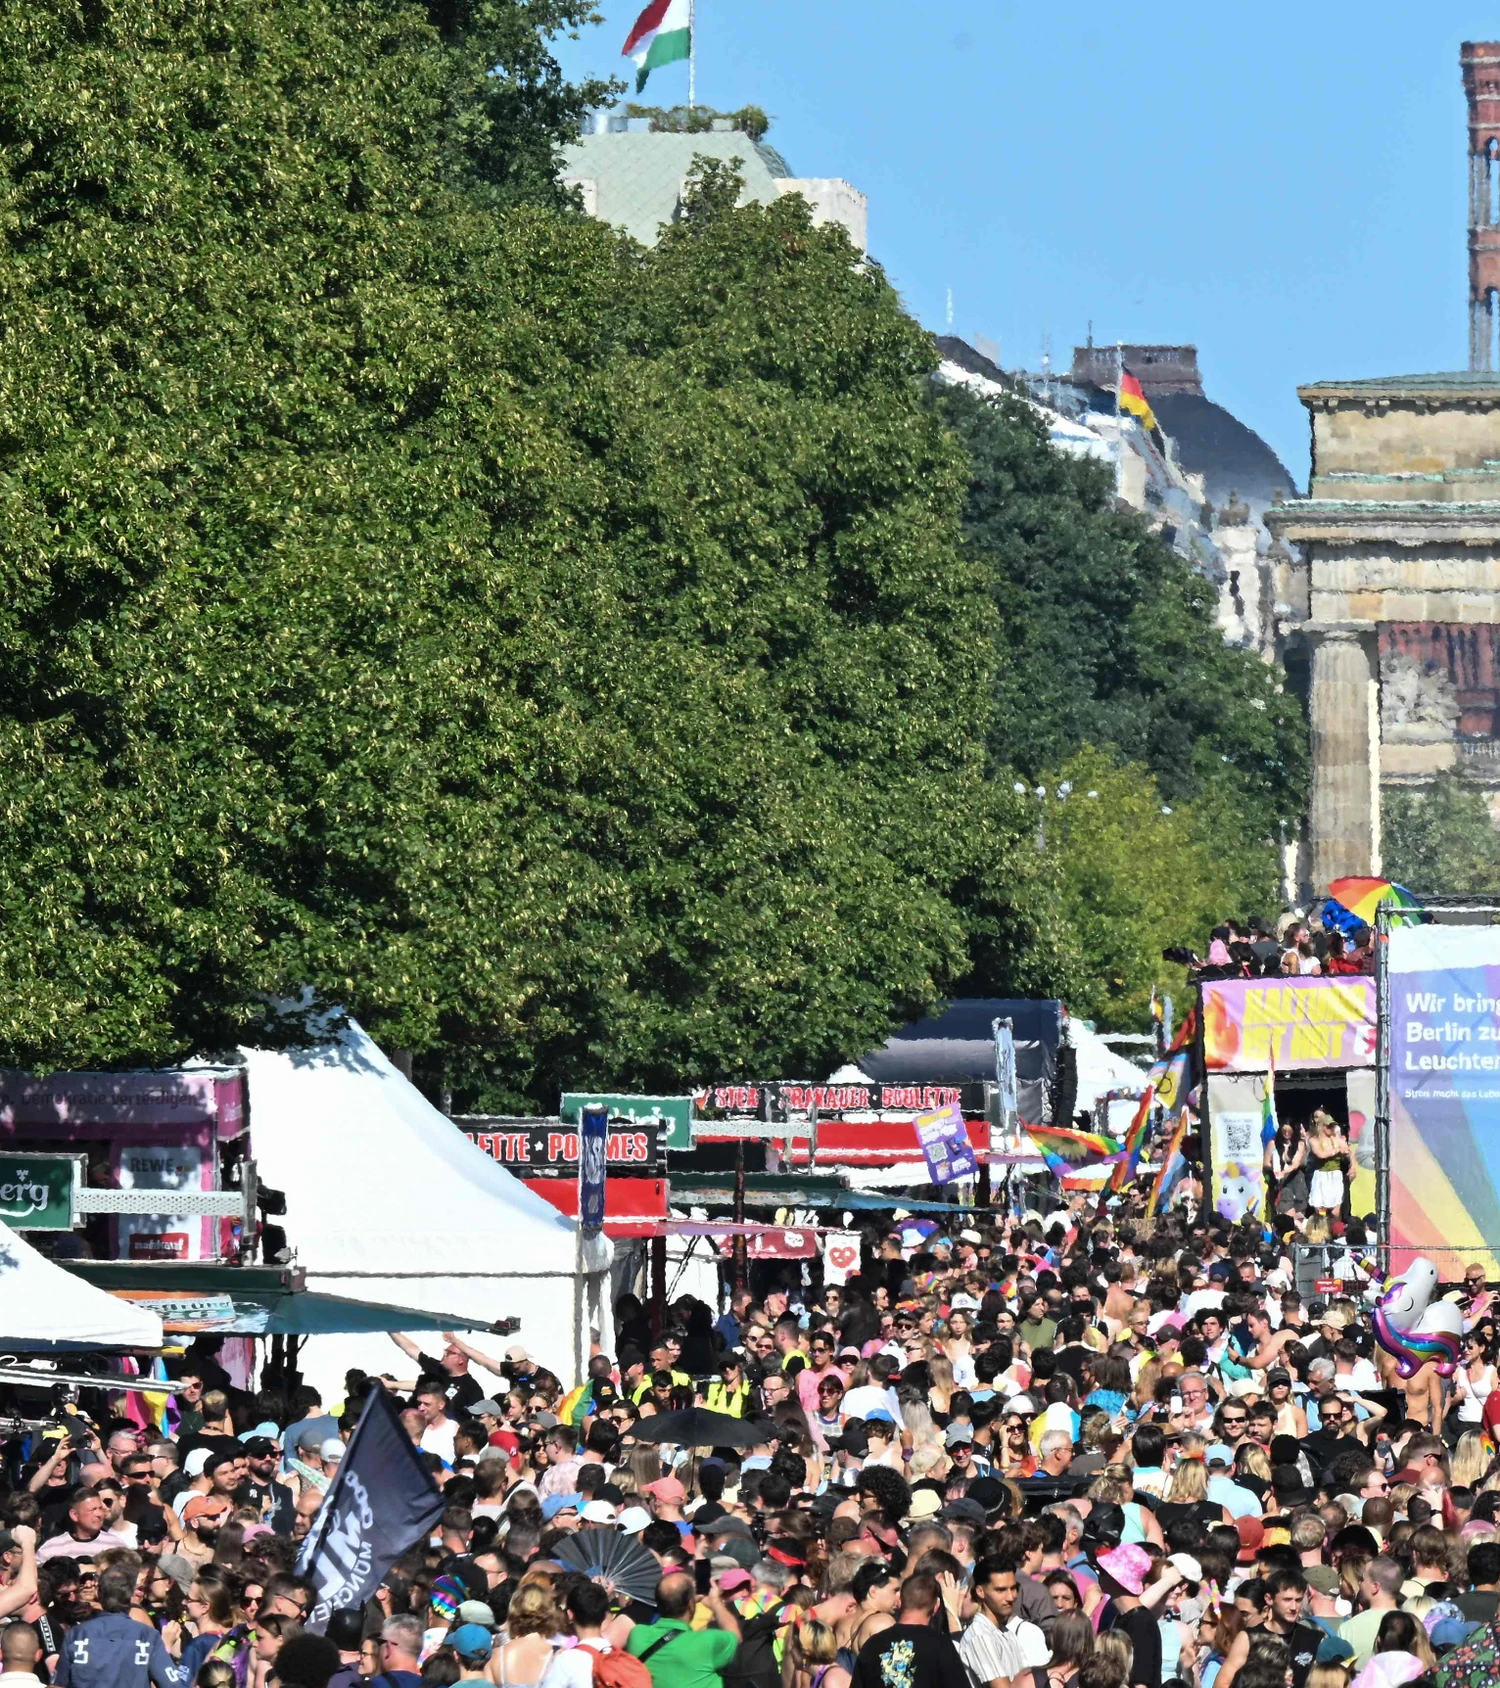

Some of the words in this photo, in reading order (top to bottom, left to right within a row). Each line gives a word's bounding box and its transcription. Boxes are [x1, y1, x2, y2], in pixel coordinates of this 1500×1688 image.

[1405, 993, 1446, 1012] Wir
[1406, 1021, 1471, 1042] Berlin
[1461, 1090, 1477, 1098] das
[131, 1158, 173, 1172] REWE
